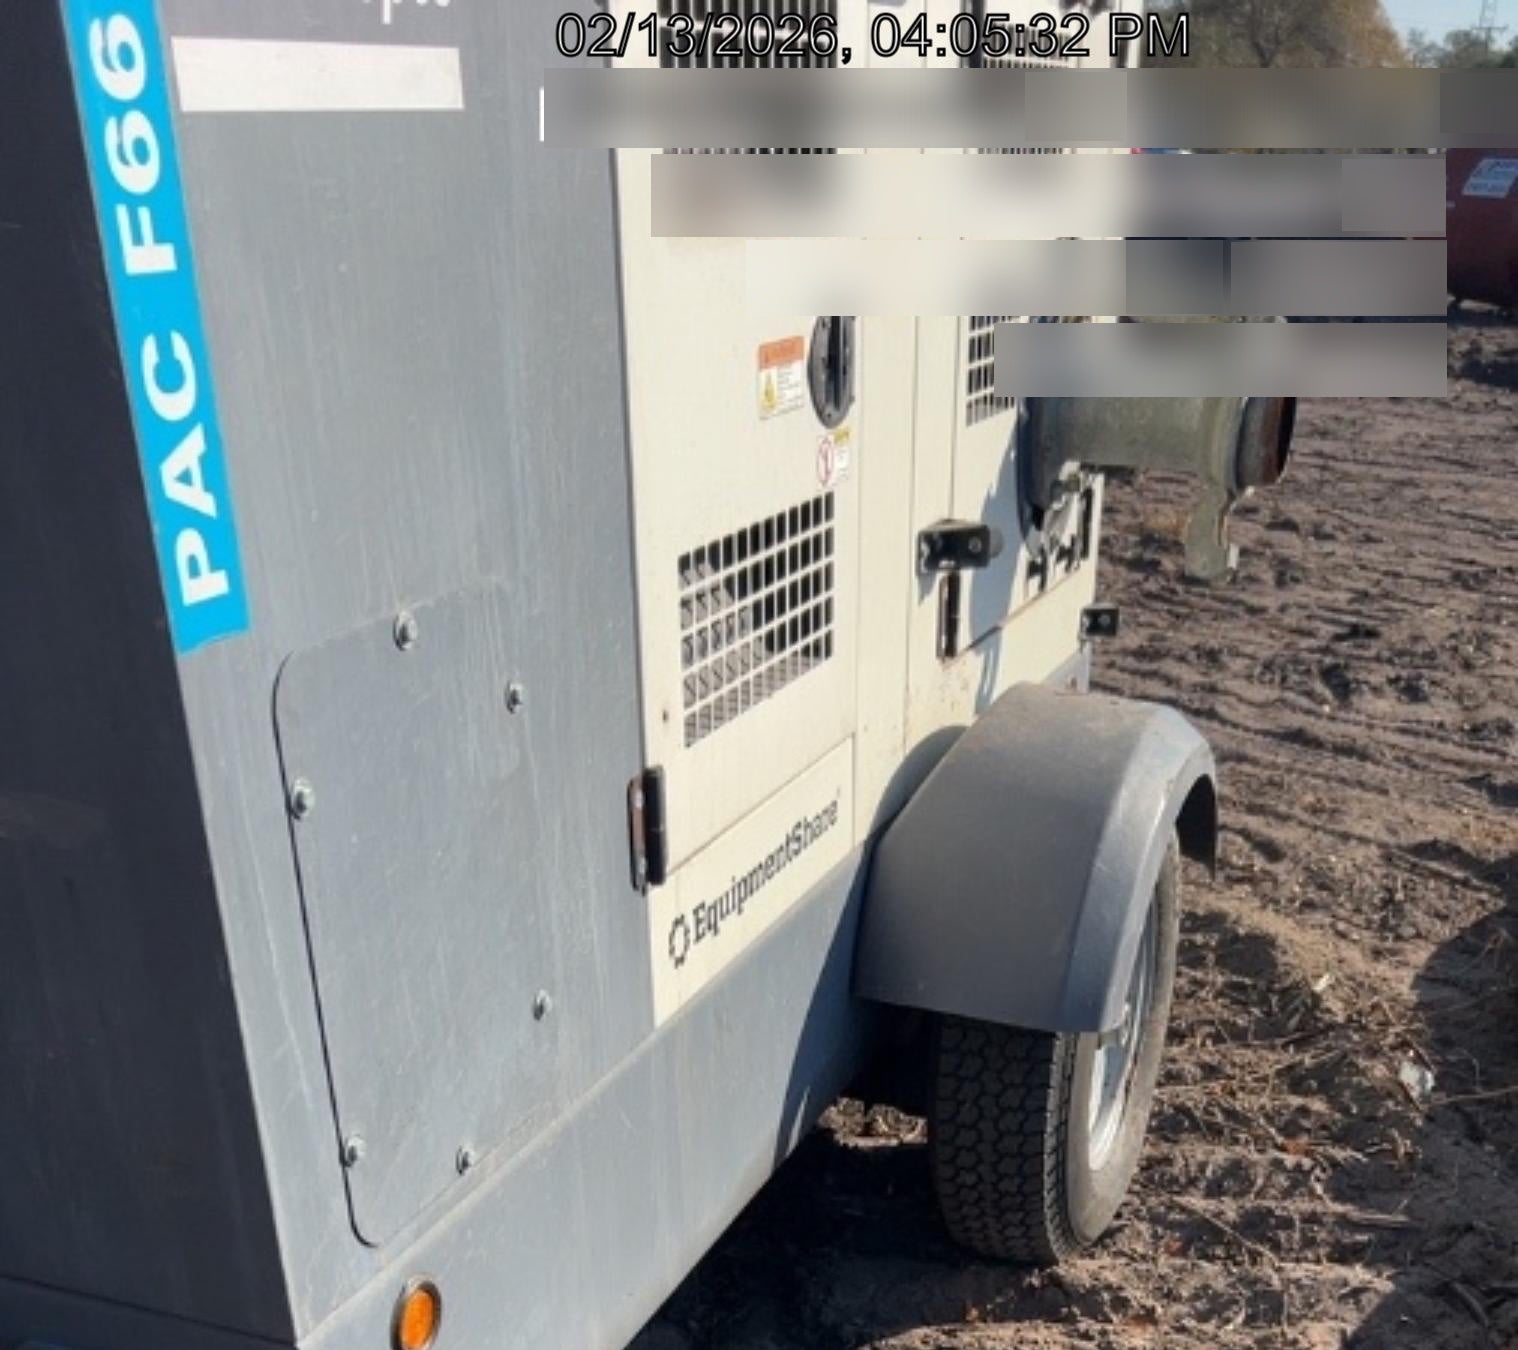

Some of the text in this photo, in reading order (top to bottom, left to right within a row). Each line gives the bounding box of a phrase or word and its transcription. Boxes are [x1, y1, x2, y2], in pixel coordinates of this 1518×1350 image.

[89, 13, 229, 607] PAC F66
[692, 799, 838, 944] EquipmentShare
